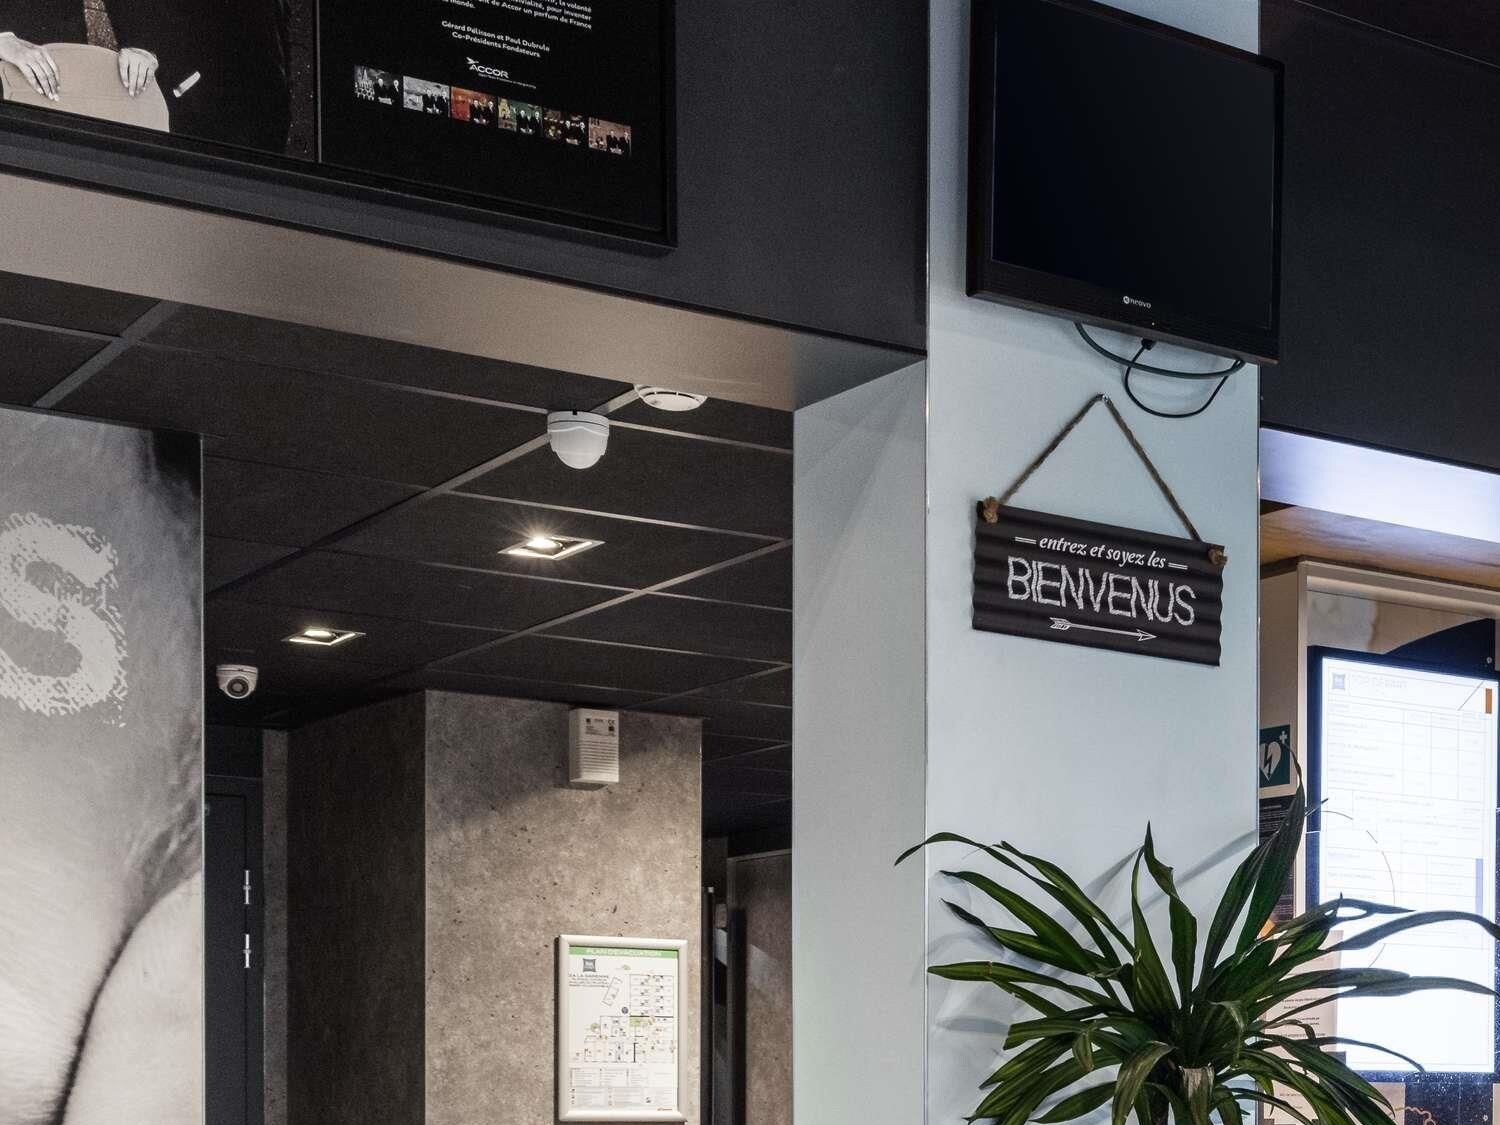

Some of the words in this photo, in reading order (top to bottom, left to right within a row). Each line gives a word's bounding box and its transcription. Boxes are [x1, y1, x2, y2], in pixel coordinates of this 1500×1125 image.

[501, 2, 522, 12] Accor
[534, 10, 559, 22] parfum
[569, 18, 592, 30] France
[564, 7, 592, 21] inventer
[441, 20, 466, 32] Gérard
[505, 35, 521, 46] Paul
[469, 63, 510, 79] ACCOR
[1039, 535, 1087, 555] entrez
[1089, 545, 1106, 558] et
[1106, 549, 1145, 568] soyez
[1147, 552, 1167, 569] les
[1006, 555, 1196, 627] BIENVENUS
